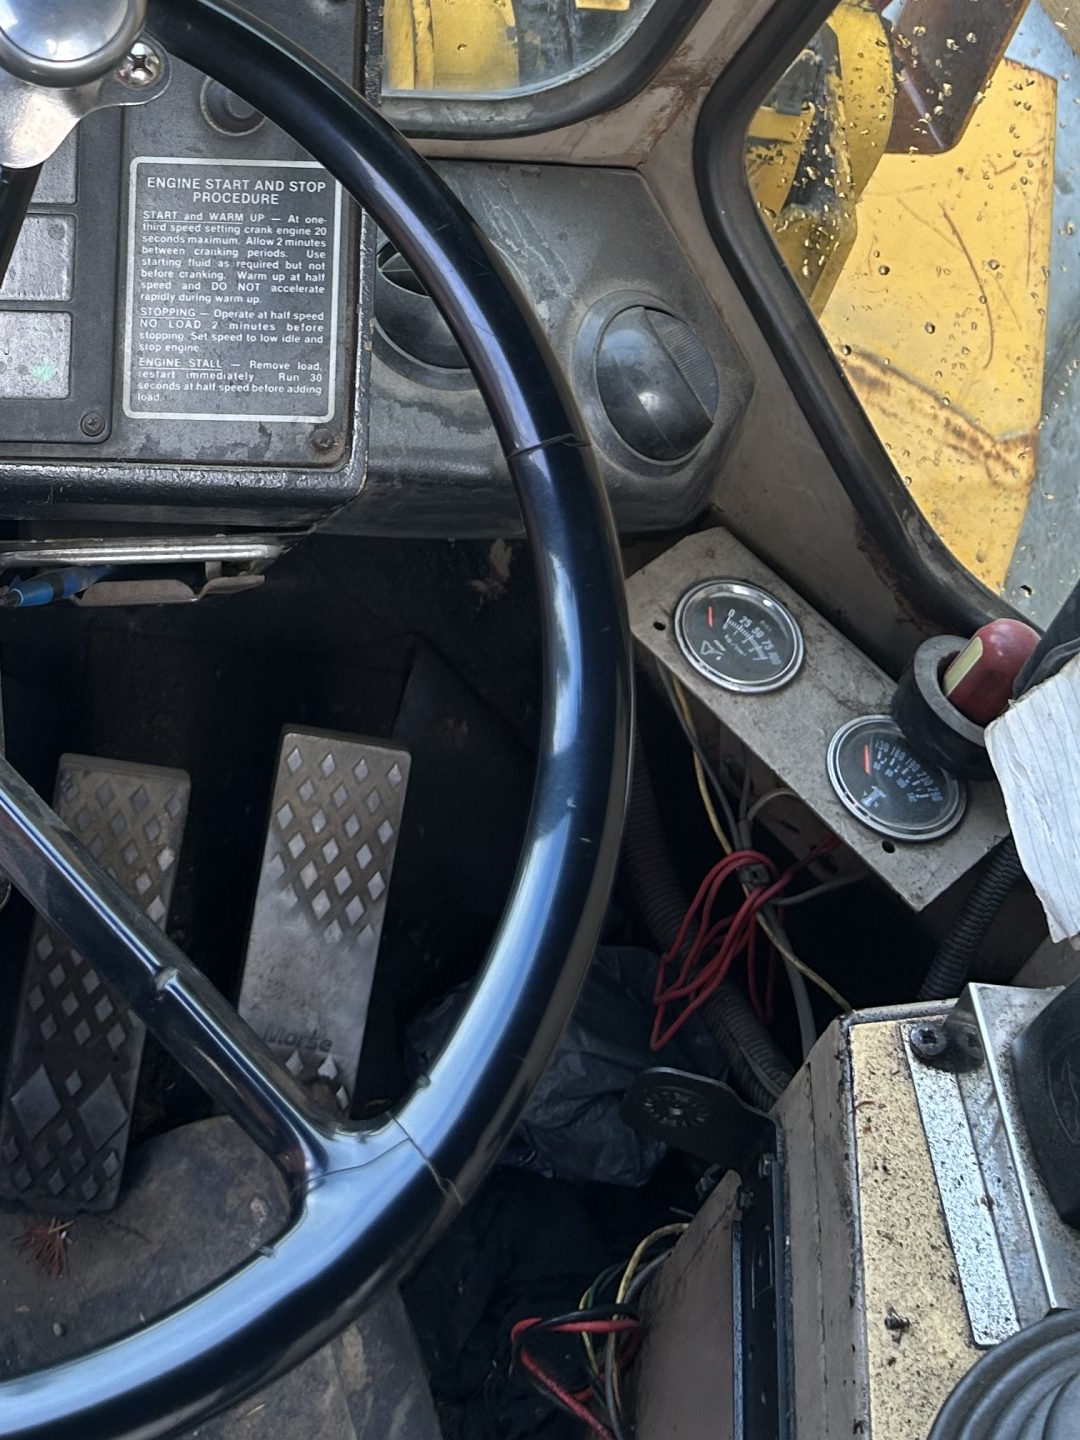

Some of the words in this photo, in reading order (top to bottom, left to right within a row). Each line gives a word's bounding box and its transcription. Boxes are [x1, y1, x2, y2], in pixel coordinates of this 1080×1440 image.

[147, 176, 201, 189] ENGINE
[205, 178, 250, 190] START
[254, 179, 284, 191] AND
[289, 180, 326, 193] STOP
[193, 192, 279, 205] PROCEDURE
[143, 211, 177, 220] START
[184, 212, 203, 221] and
[209, 212, 244, 222] WARM
[250, 213, 265, 223] UP
[288, 215, 300, 224] At
[143, 223, 166, 232] third
[170, 224, 201, 234] speed
[204, 225, 241, 236] setting
[244, 225, 273, 234] crank
[276, 227, 311, 237] engine
[314, 227, 327, 236] 20
[142, 236, 185, 244] seconds
[245, 237, 274, 246] Allow
[276, 238, 283, 246] 2
[285, 239, 327, 248] minutes
[142, 246, 185, 255] between
[194, 248, 239, 258] cranking
[247, 249, 288, 259] periods.
[306, 250, 326, 259] Use
[141, 258, 182, 268] starting
[188, 259, 211, 268] fluid
[236, 260, 279, 270] required
[285, 261, 302, 270] but
[308, 262, 326, 271] not
[141, 269, 175, 279] before
[179, 271, 226, 281] cranking.
[237, 272, 267, 281] Warm
[272, 274, 285, 283] up
[290, 273, 301, 282] at
[305, 273, 326, 282] half
[140, 282, 172, 291] speed
[182, 282, 201, 291] and
[211, 282, 228, 291] DO
[237, 283, 261, 292] NOT
[271, 284, 325, 294] accelerate
[140, 293, 175, 303] rapidly
[178, 294, 212, 304] during
[214, 295, 244, 303] warm
[247, 296, 262, 305] up.
[140, 308, 196, 317] STOPPING
[213, 309, 255, 320] Operate
[257, 311, 268, 319] at
[271, 311, 291, 319] half
[293, 312, 324, 322] speed
[140, 319, 158, 328] NO
[169, 320, 201, 329] LOAD
[212, 321, 219, 330] 2
[229, 321, 276, 331] minutes
[286, 323, 324, 332] before
[191, 332, 207, 341] Set
[211, 333, 243, 343] speed
[246, 334, 257, 342] to
[260, 334, 278, 342] low
[281, 334, 301, 343] idle
[304, 335, 323, 344] and
[139, 343, 162, 354] stop
[139, 358, 181, 367] ENGINE
[188, 359, 222, 368] STALL
[250, 361, 290, 370] Remove
[138, 370, 175, 379] restart
[278, 373, 300, 382] Run
[309, 373, 322, 382] 30
[138, 381, 181, 391] seconds
[183, 383, 194, 391] at
[196, 383, 216, 391] half
[219, 384, 250, 394] speed
[251, 384, 285, 394] before
[287, 385, 322, 396] adding
[728, 608, 736, 618] 0
[740, 616, 753, 627] 25
[751, 627, 764, 638] 50
[762, 640, 775, 650] 75
[875, 739, 889, 753] 130
